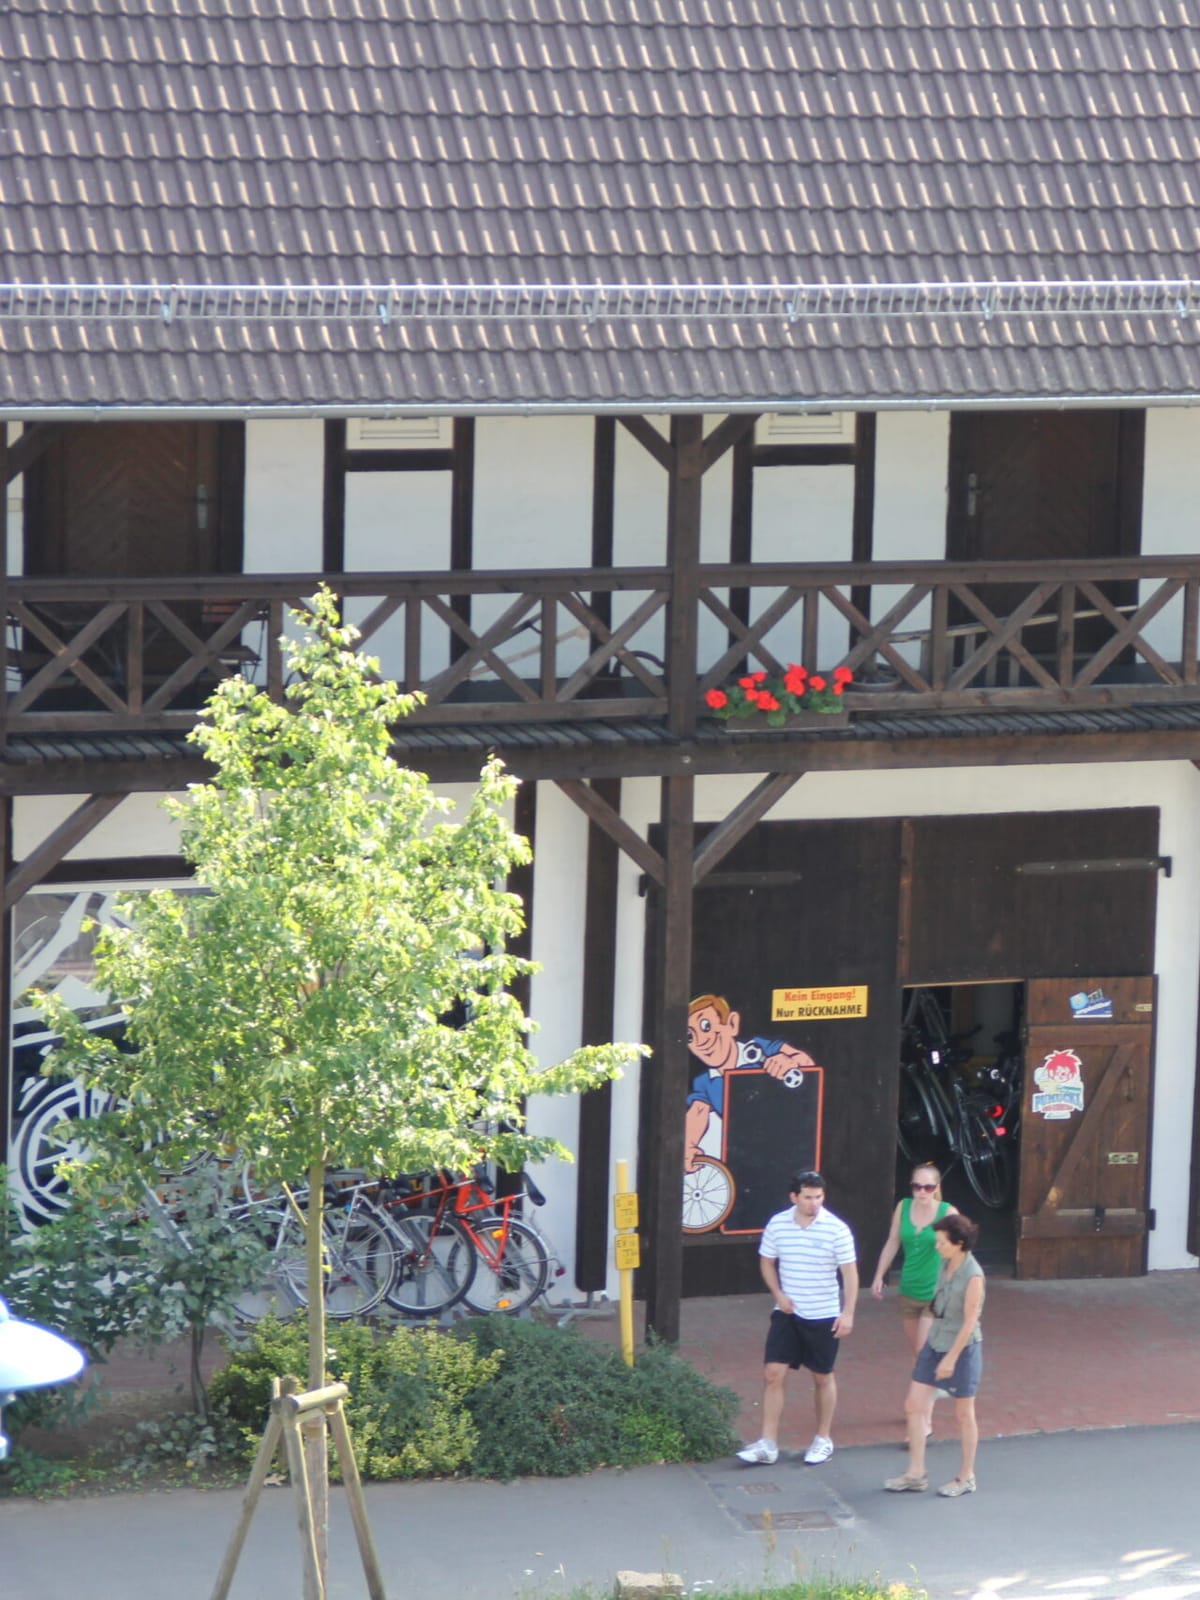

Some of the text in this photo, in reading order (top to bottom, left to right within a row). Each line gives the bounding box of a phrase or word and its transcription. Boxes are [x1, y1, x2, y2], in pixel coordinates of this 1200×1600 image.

[784, 988, 856, 1002] Kein Eingang!
[776, 1003, 862, 1018] Nur RÜCKNAHME
